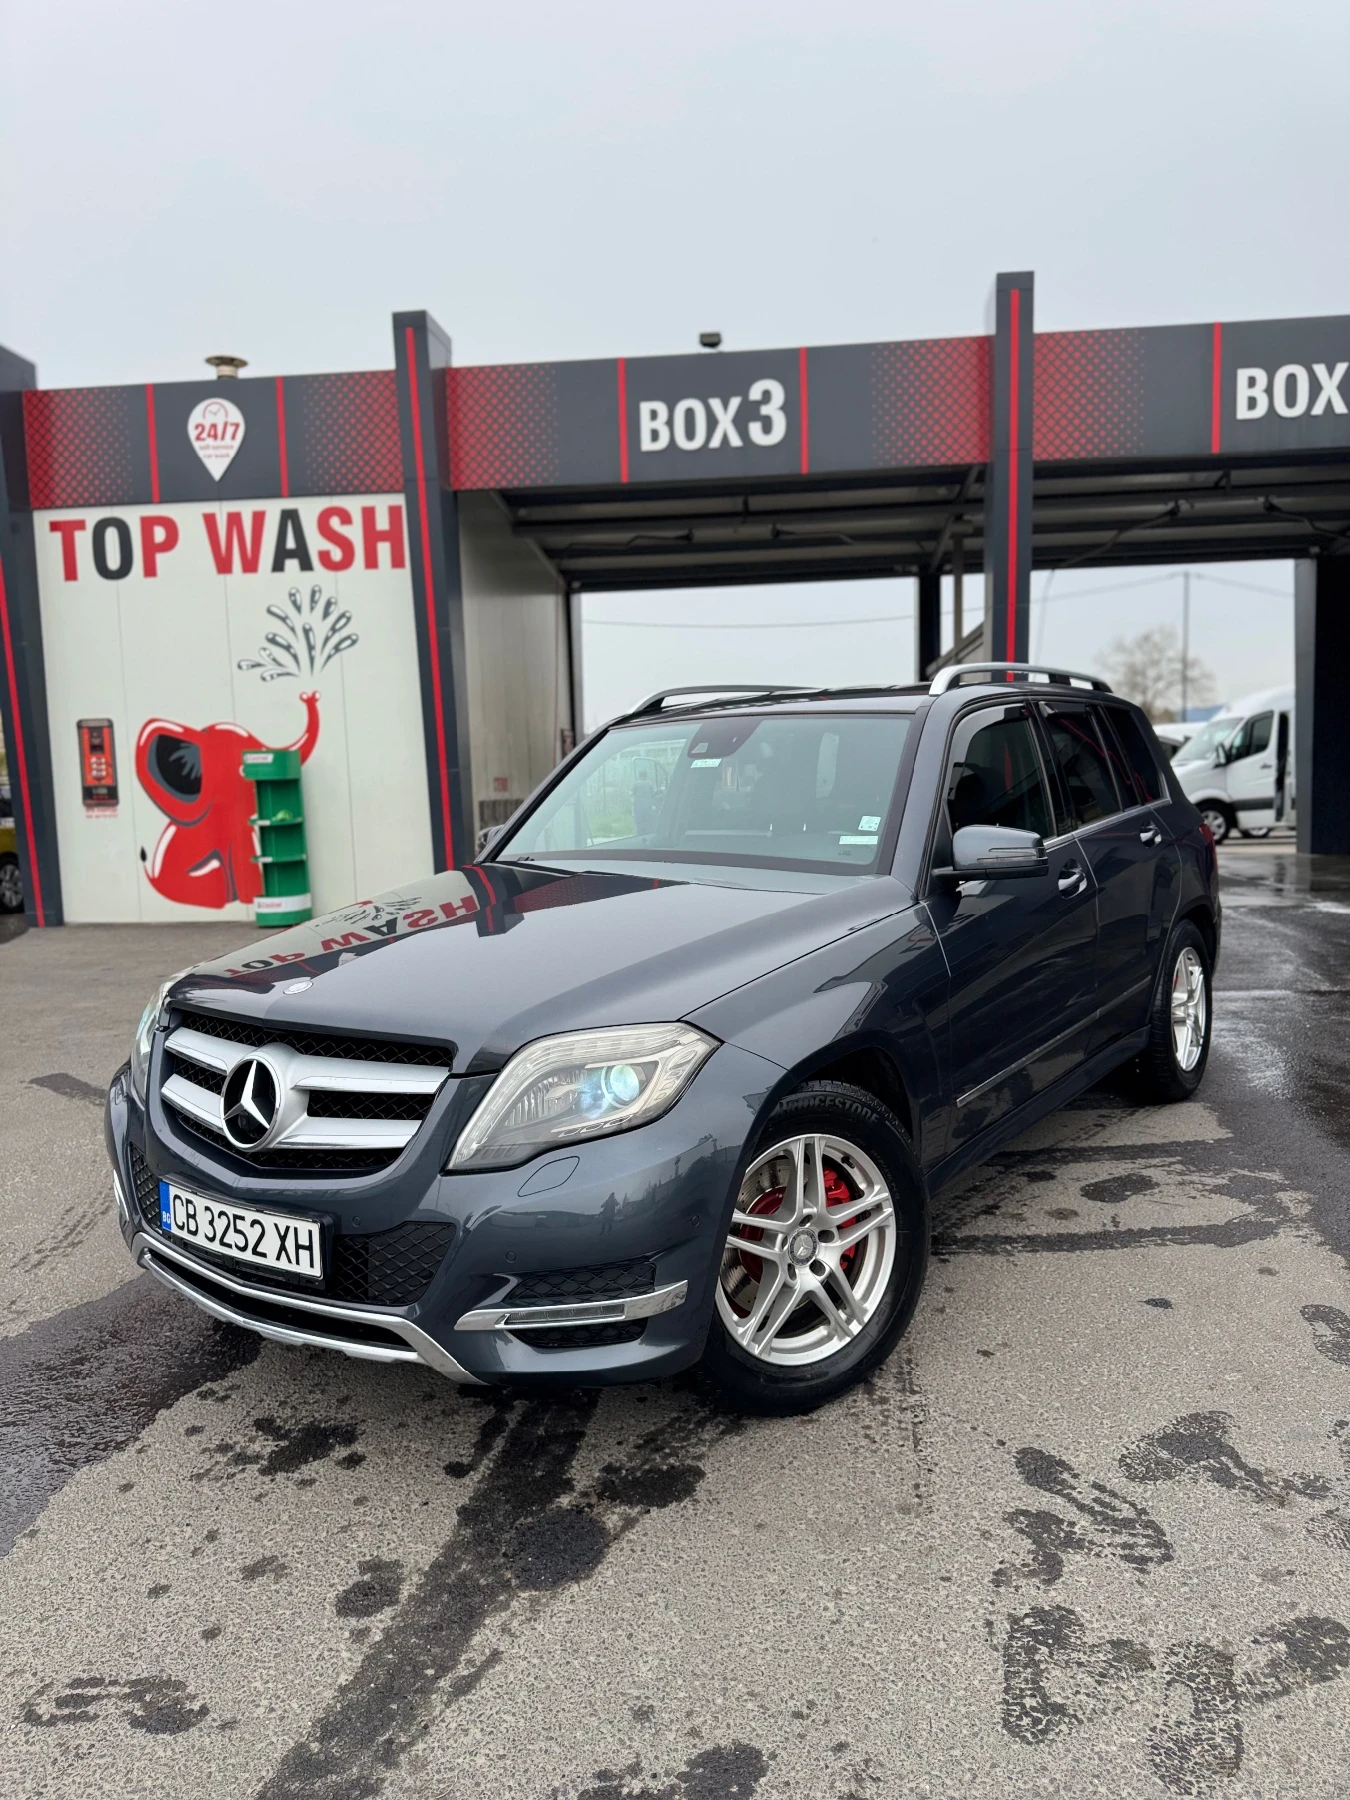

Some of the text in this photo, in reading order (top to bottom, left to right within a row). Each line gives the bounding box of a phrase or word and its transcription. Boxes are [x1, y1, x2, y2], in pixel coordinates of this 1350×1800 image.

[1236, 361, 1349, 420] BOX
[194, 420, 241, 442] 24/7
[49, 504, 406, 582] TOP WASH
[162, 1211, 171, 1224] BG
[173, 1194, 315, 1269] CB 3252 XH
